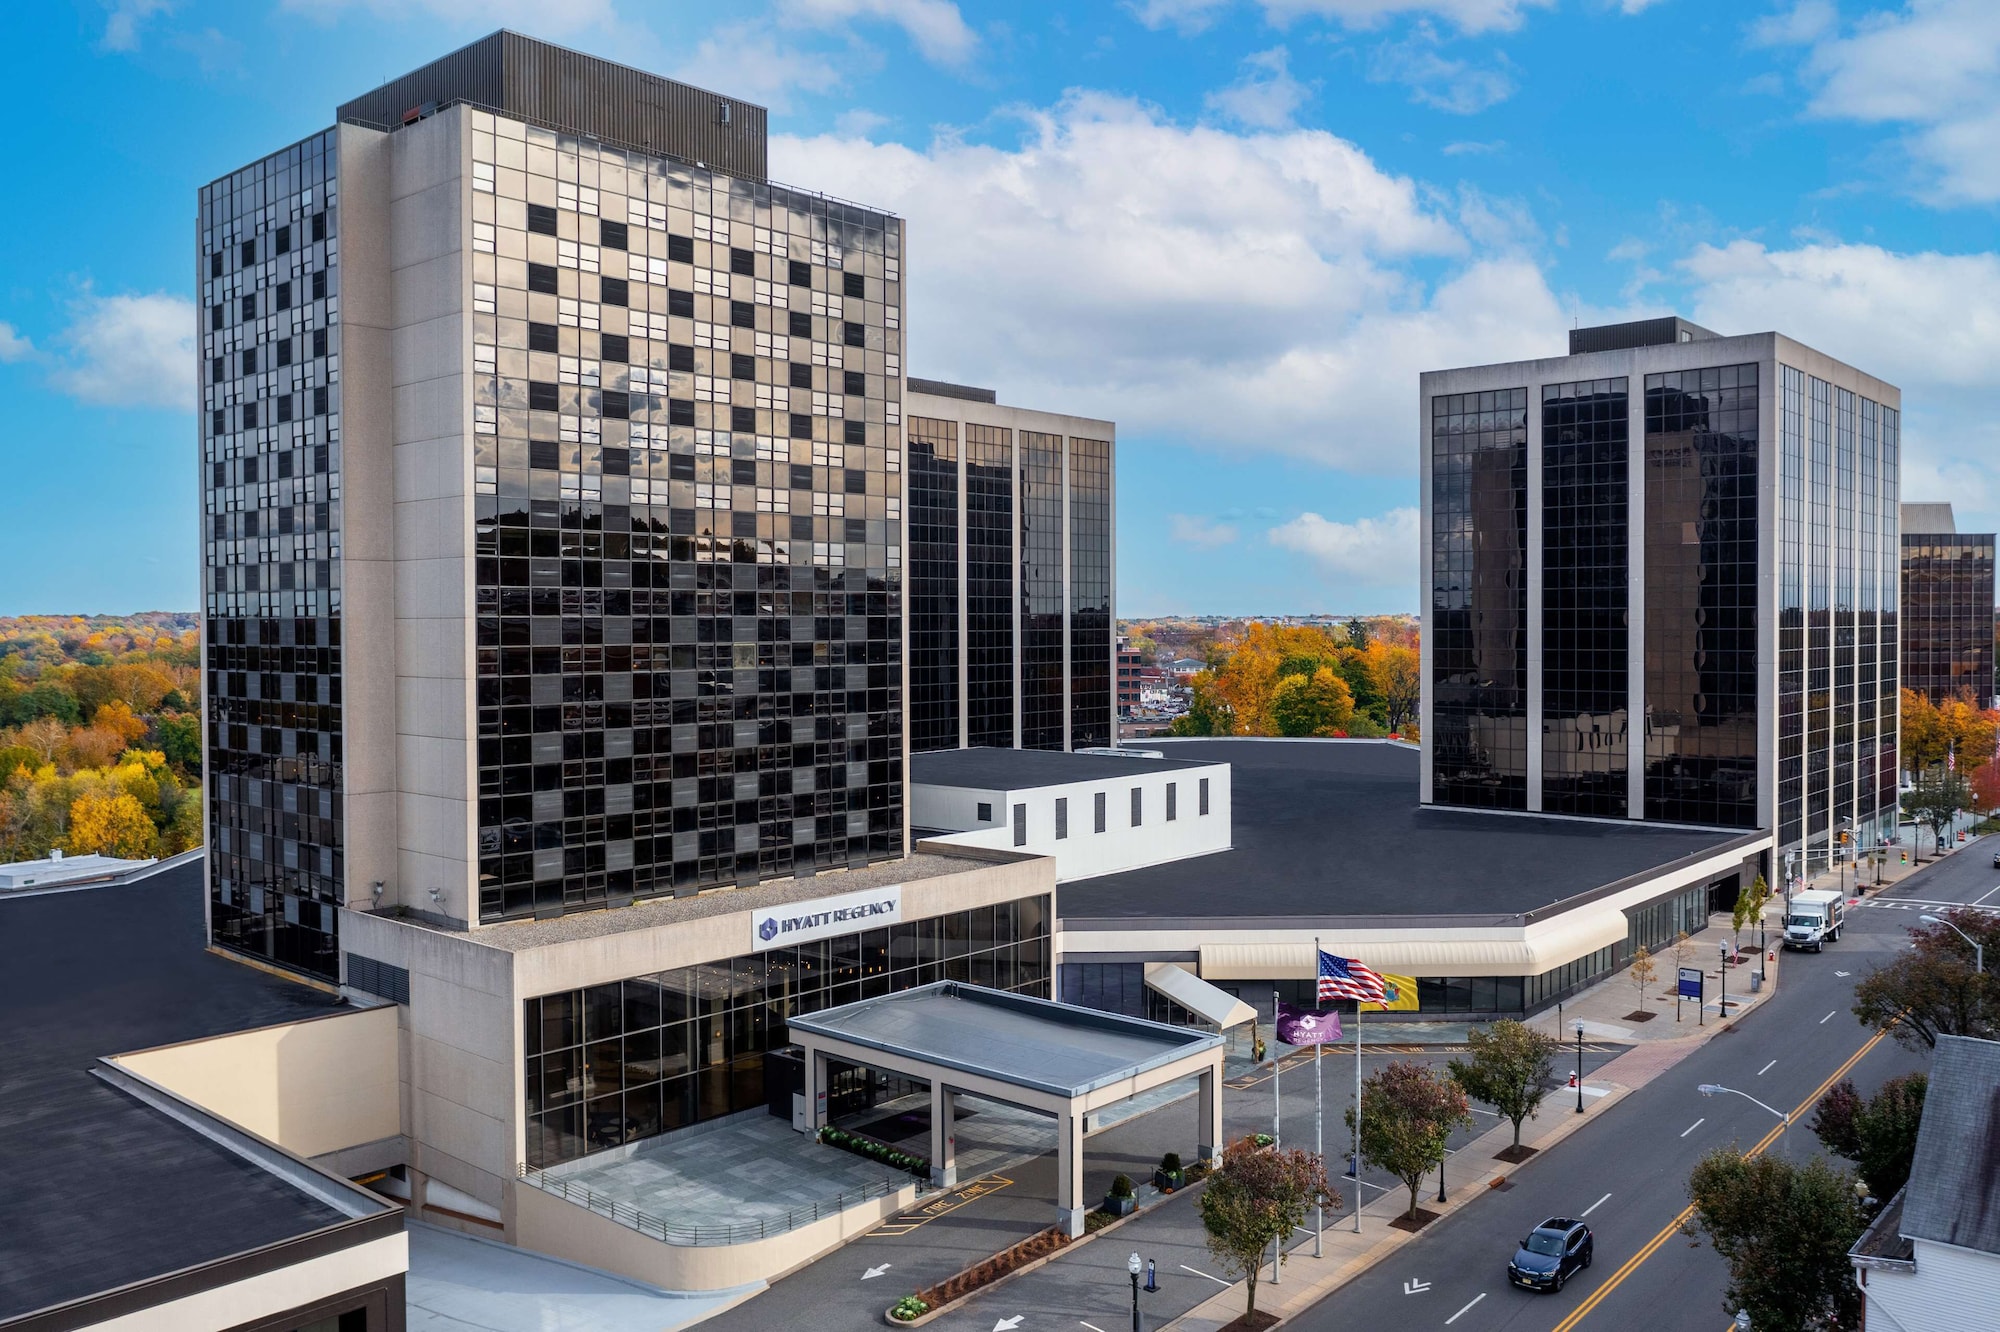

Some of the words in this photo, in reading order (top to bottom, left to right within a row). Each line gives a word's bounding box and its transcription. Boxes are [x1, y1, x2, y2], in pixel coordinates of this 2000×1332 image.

[782, 911, 832, 933] HYATT
[833, 899, 897, 922] REGENCY
[1293, 1030, 1324, 1039] HYATT
[922, 1199, 954, 1215] FIRE
[955, 1184, 989, 1200] ZONE
